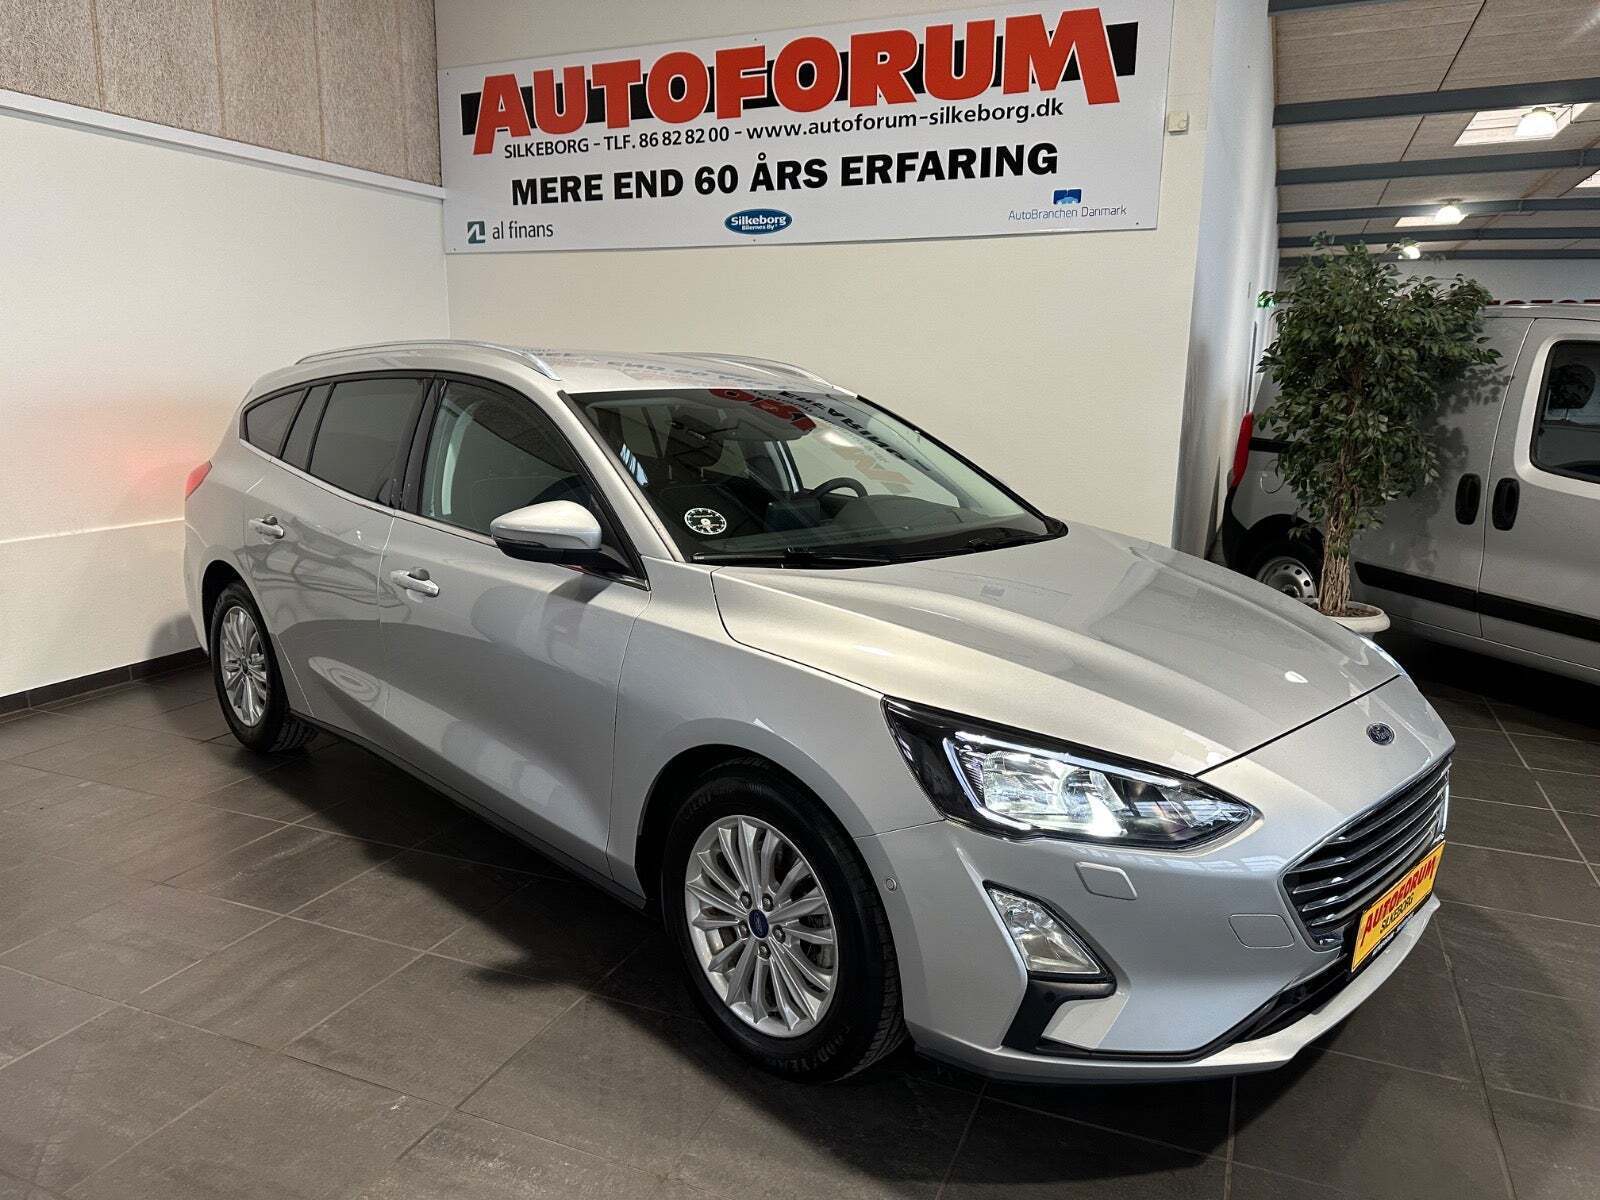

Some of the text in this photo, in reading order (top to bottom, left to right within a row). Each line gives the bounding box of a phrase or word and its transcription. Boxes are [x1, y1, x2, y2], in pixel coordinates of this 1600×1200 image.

[472, 7, 1121, 156] AUTOFORUM
[504, 138, 590, 159] SILKEBORG
[603, 134, 636, 151] TLF.
[746, 98, 1064, 140] www.autoforum-silkeborg.dk
[512, 142, 1058, 205] MERE END 60 ÅRS ERFARING
[492, 220, 553, 240] al finans
[730, 215, 787, 226] Silkeborg
[1008, 204, 1127, 221] AutoBranchen Danmark
[1360, 856, 1437, 947] AUTOFORUM
